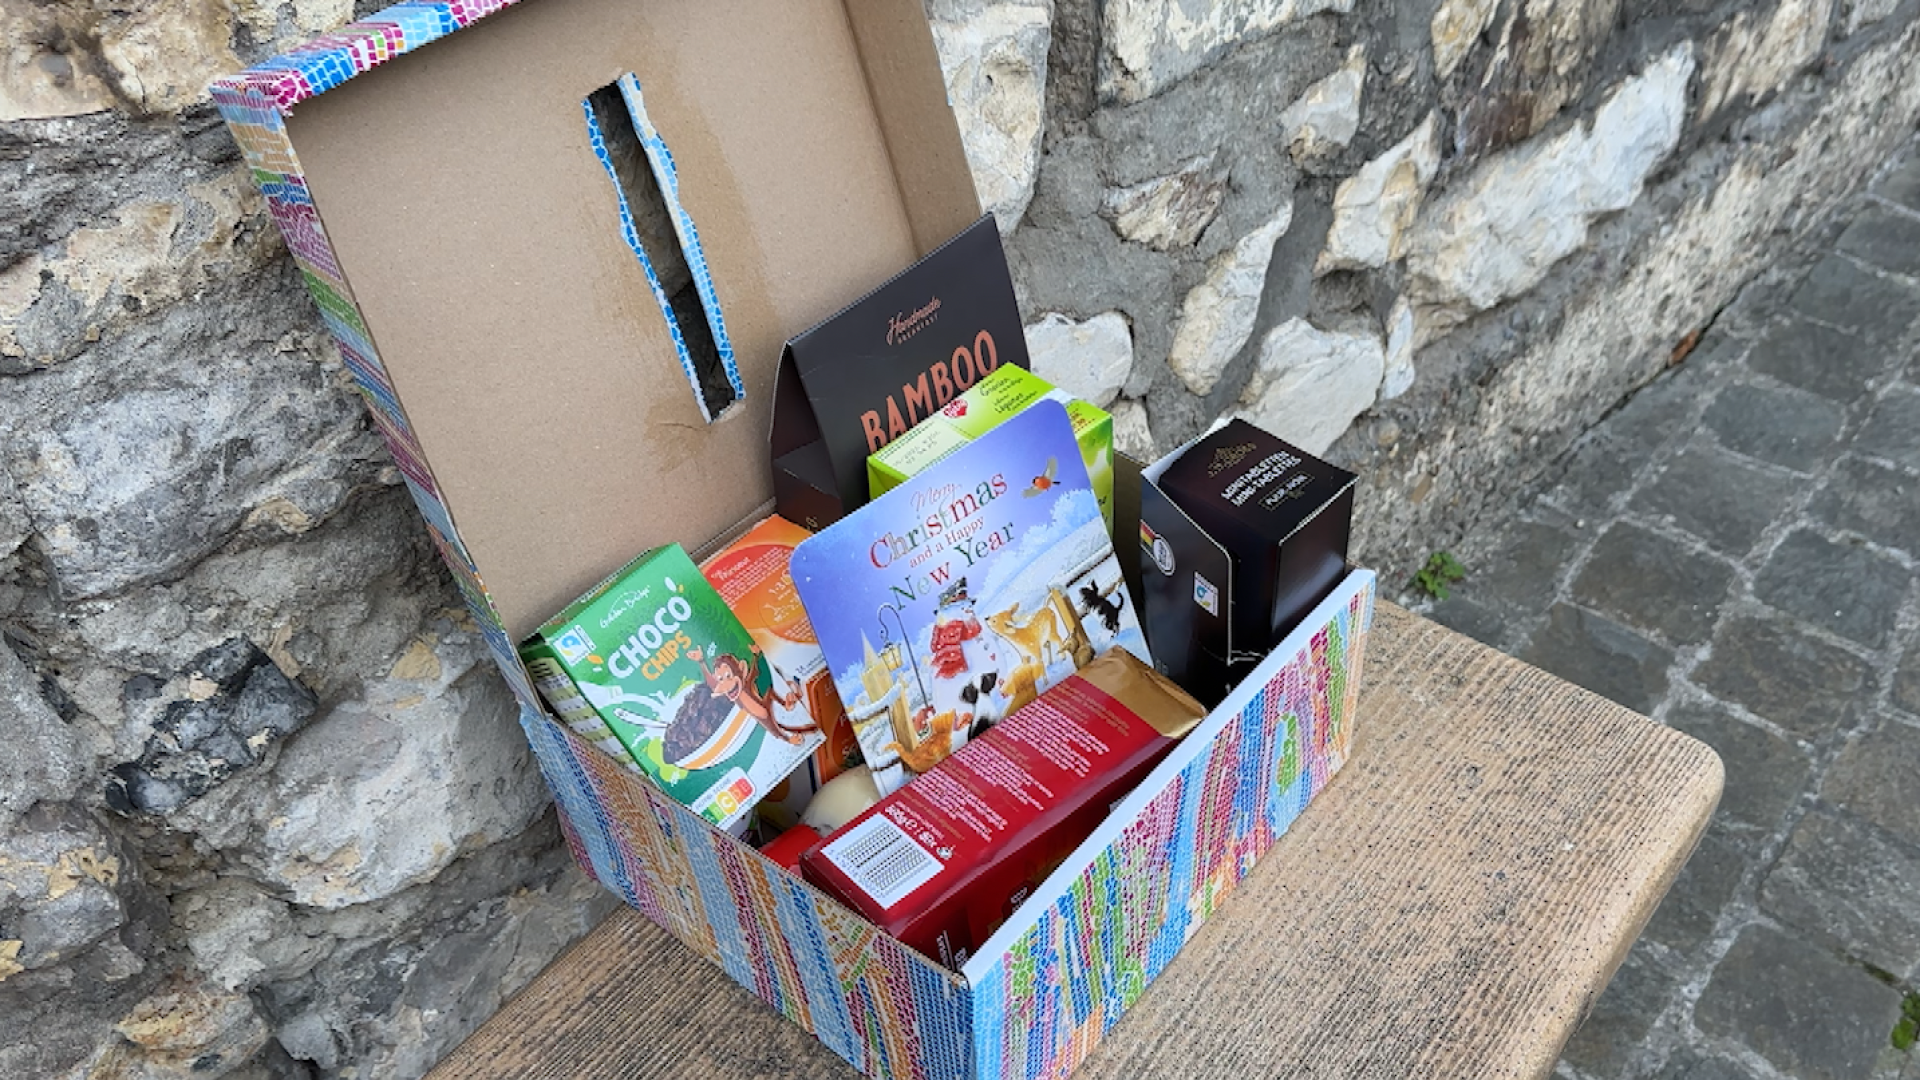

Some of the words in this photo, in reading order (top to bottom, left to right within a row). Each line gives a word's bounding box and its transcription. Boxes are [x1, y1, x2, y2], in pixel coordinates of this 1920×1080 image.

[860, 329, 998, 454] BAMBOO
[869, 473, 1008, 569] Christmas
[910, 483, 962, 512] Merry
[889, 561, 951, 611] New
[953, 521, 1015, 568] Year
[909, 545, 933, 568] and
[935, 542, 944, 554] a
[944, 516, 984, 546] Happy
[608, 596, 692, 679] CHOCO
[641, 629, 692, 681] CHIPS
[721, 795, 734, 808] C
